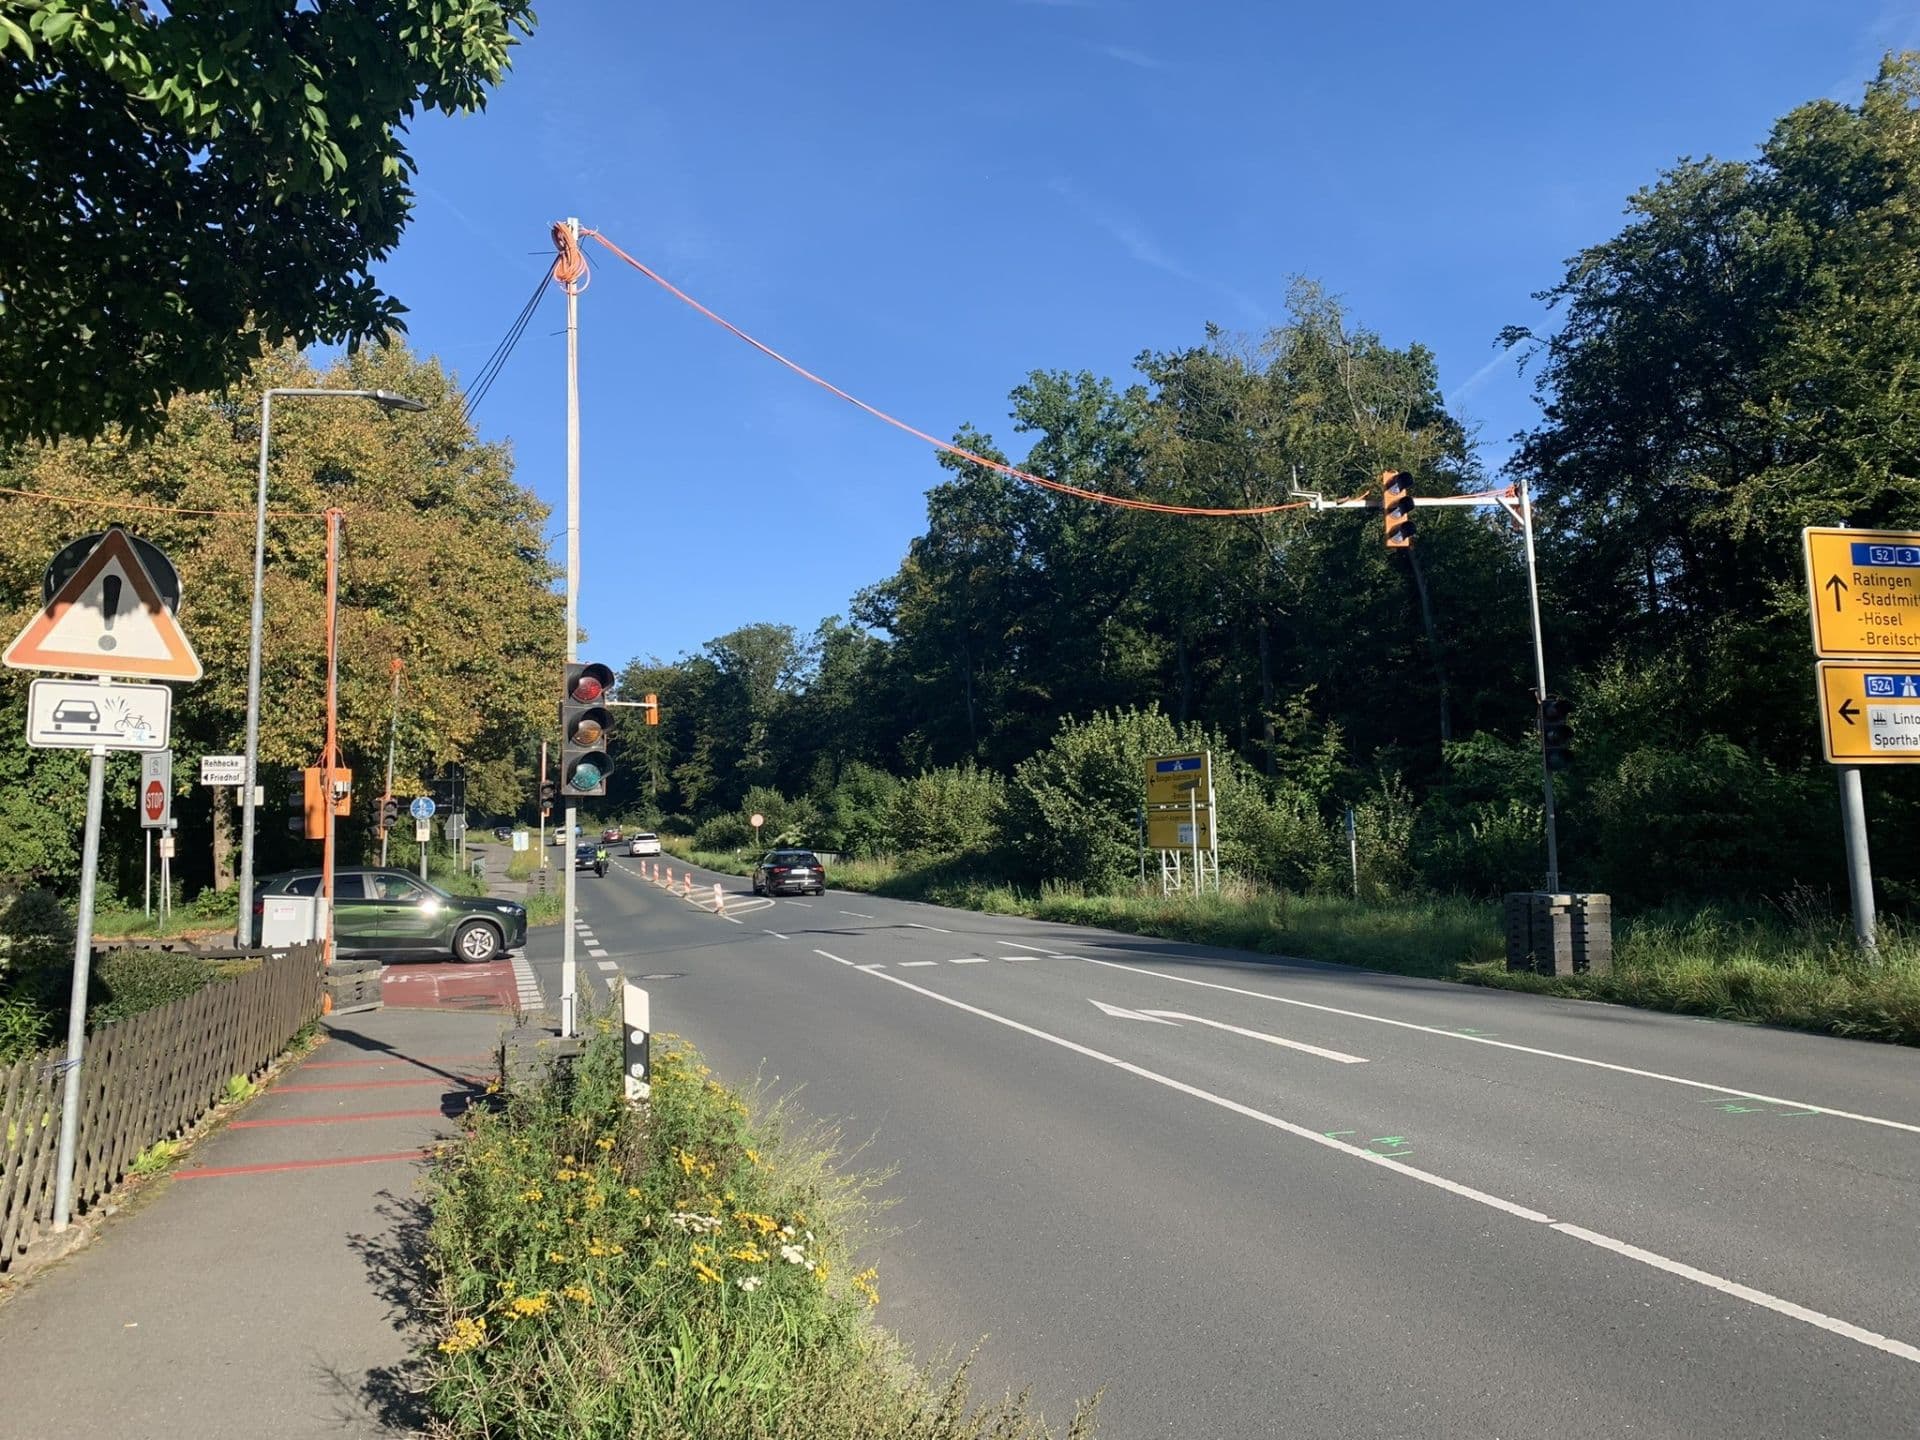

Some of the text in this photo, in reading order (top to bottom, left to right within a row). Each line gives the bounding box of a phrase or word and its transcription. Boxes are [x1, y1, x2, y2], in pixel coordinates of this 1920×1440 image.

[1876, 550, 1912, 562] 52 3
[1853, 572, 1912, 590] Ratingen
[1872, 680, 1891, 692] 524
[210, 773, 240, 781] Friedhof
[146, 792, 164, 809] STOP
